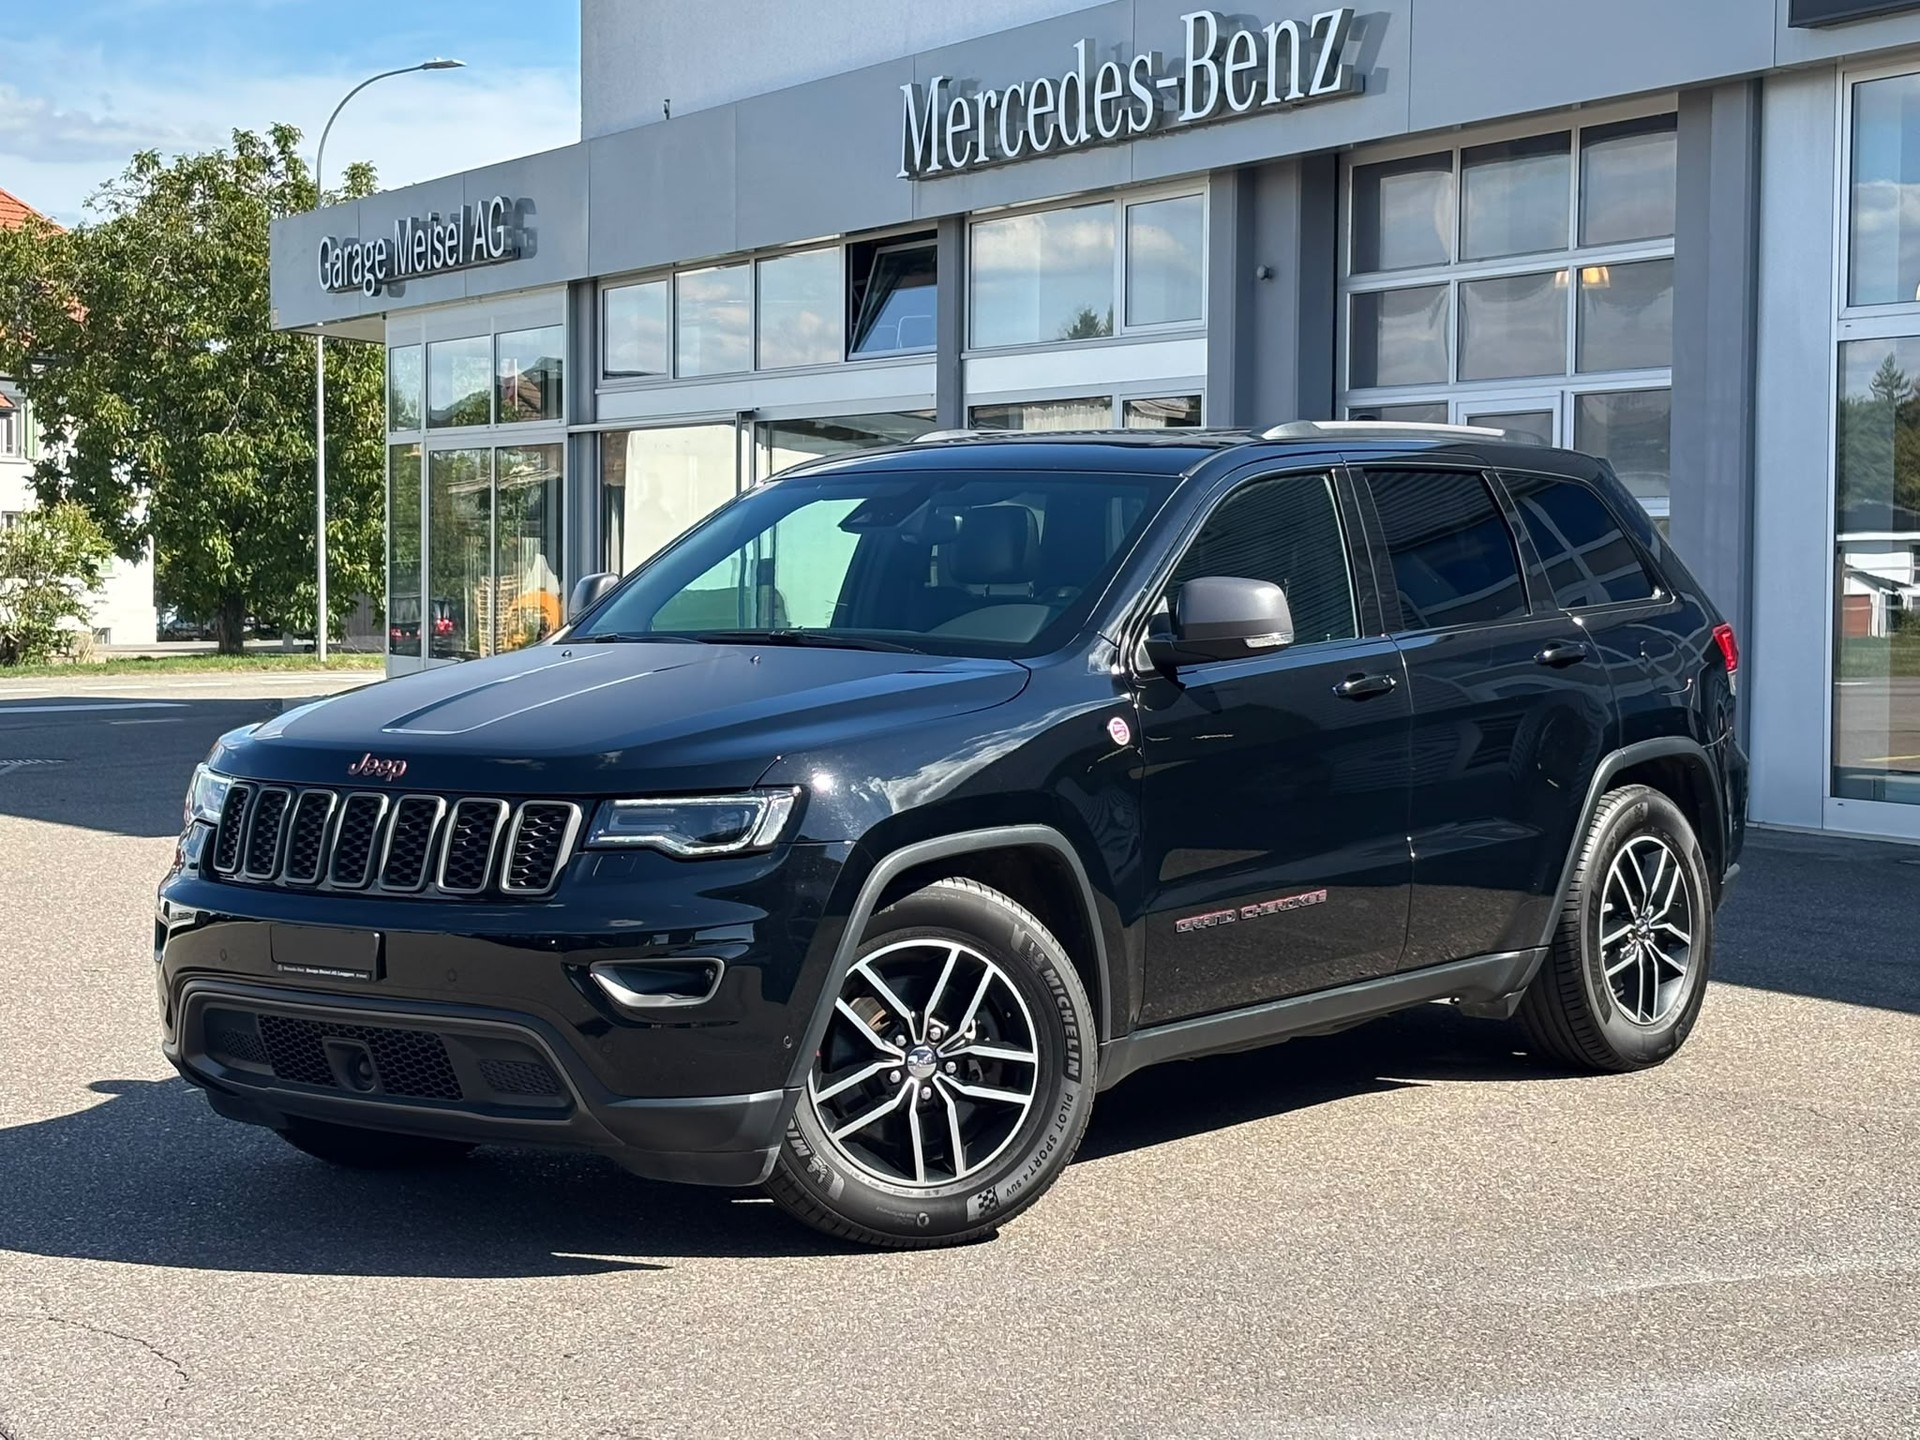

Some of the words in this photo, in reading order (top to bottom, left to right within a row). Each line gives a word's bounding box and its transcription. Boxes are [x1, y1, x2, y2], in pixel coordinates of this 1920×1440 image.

[896, 8, 1355, 179] Mercedes-Benz
[318, 236, 386, 296] Garage
[394, 205, 464, 275] Meisel
[471, 196, 505, 260] AG
[348, 752, 407, 782] Jeep
[1176, 909, 1237, 933] GRAND
[1240, 889, 1328, 920] CHEROKEE
[1042, 968, 1080, 1077] MICHELIN
[1055, 1092, 1074, 1132] PILOT
[1028, 1134, 1058, 1176] SPORT
[1006, 1179, 1022, 1197] SUV
